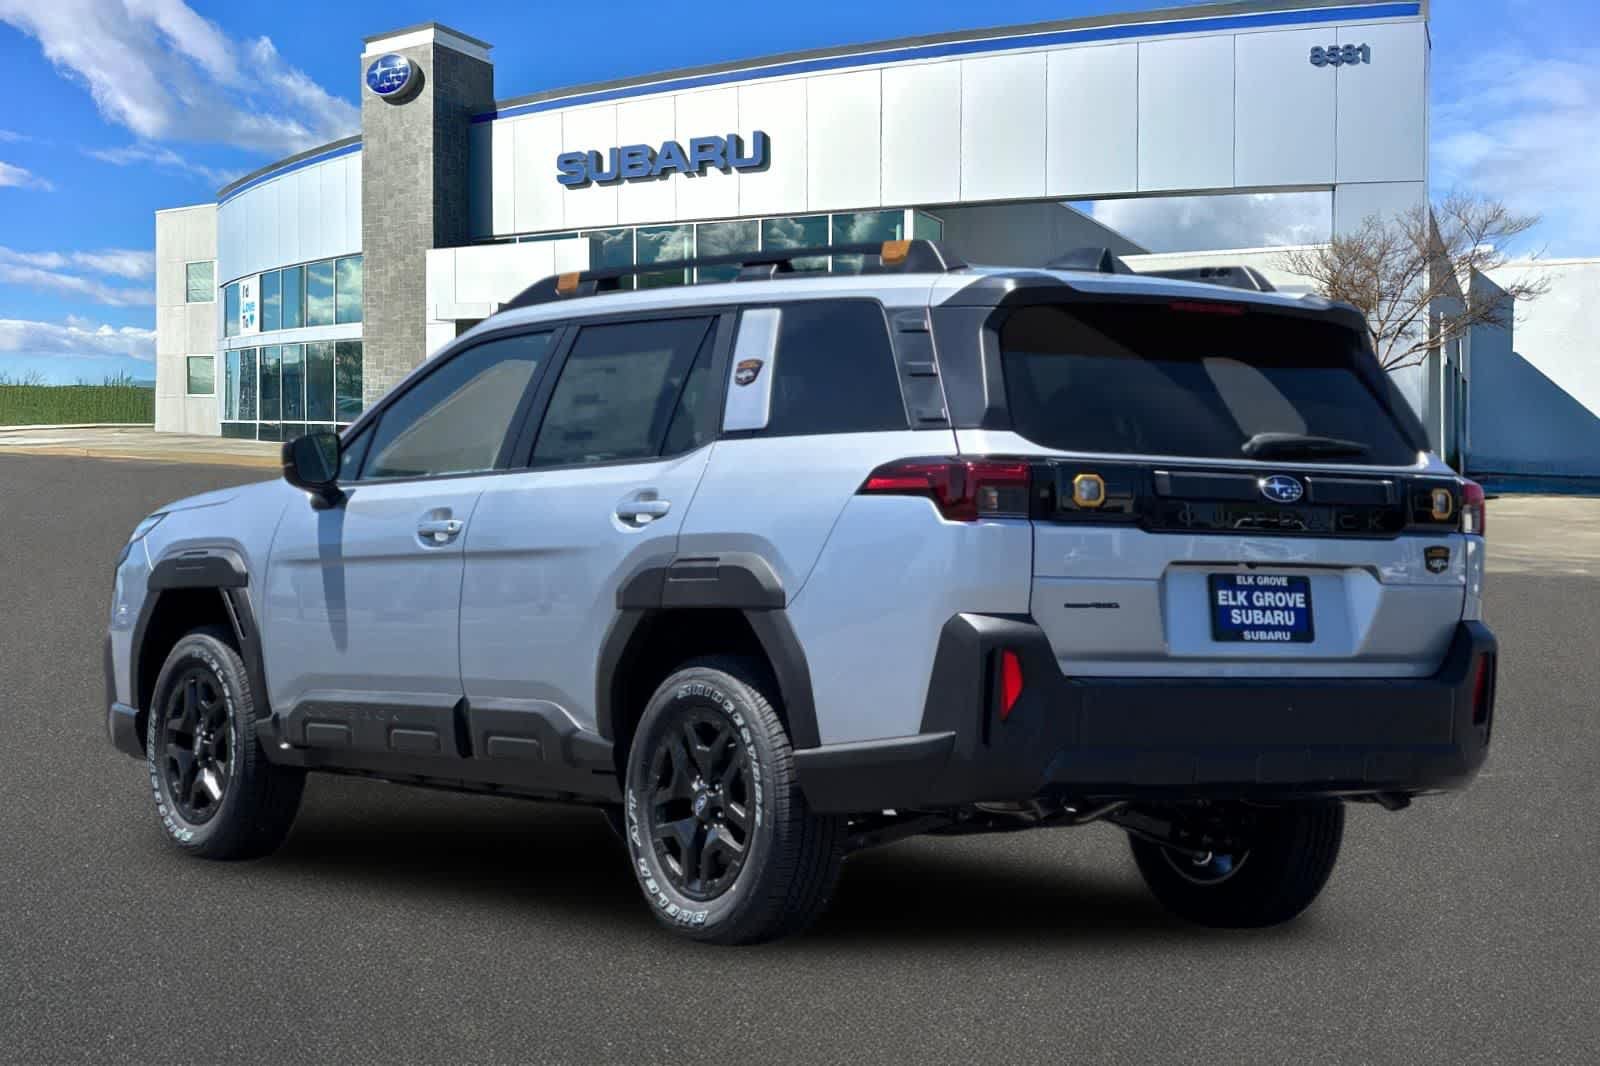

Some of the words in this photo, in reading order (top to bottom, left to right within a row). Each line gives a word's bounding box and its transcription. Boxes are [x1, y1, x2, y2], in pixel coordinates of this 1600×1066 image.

[556, 131, 770, 189] SUBARU
[1236, 575, 1255, 585] ELK
[1257, 576, 1288, 586] GROVE
[1217, 590, 1248, 607] ELK
[1252, 591, 1306, 608] GROVE
[1231, 609, 1295, 626] SUBARU
[1243, 631, 1291, 641] SUBARU
